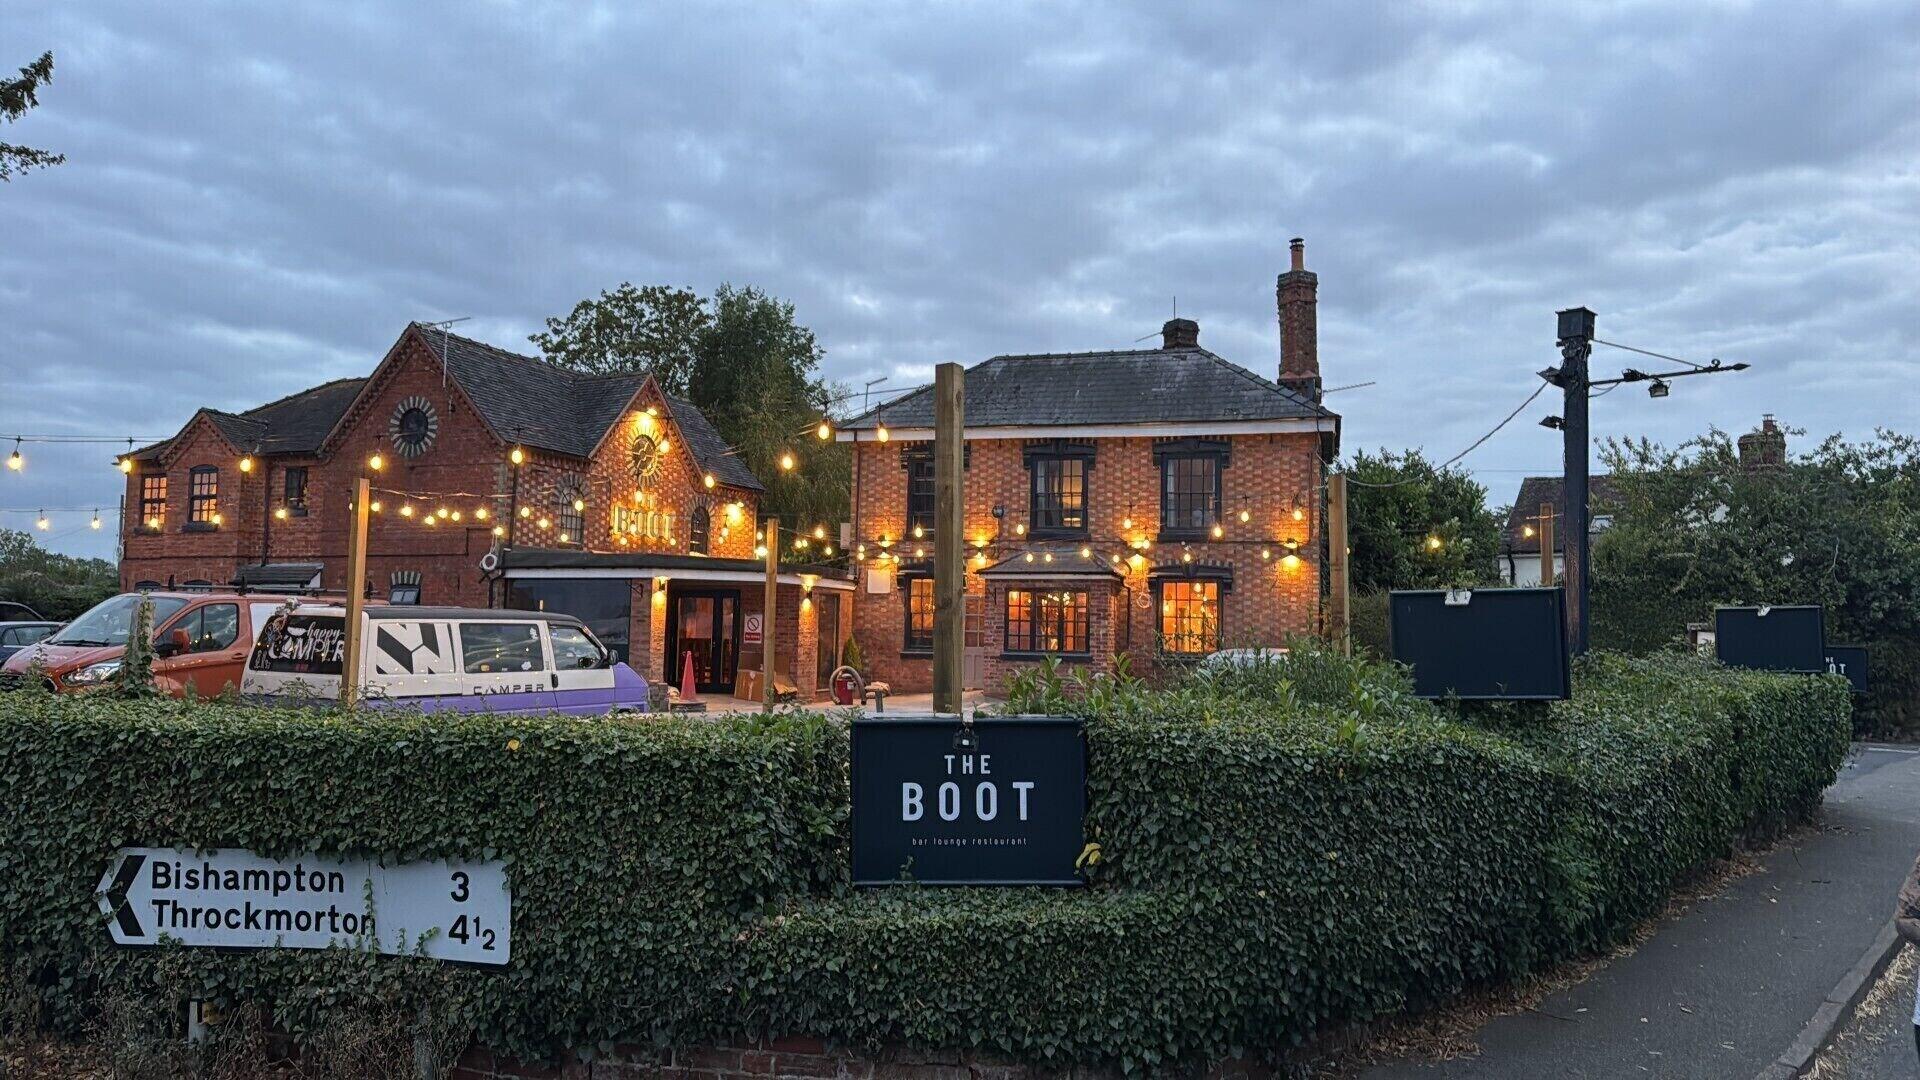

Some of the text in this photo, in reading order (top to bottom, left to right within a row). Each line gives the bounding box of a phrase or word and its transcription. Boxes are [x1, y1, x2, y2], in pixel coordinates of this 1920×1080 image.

[944, 755, 991, 775] THE
[902, 781, 1035, 822] BOOT
[912, 837, 1028, 847] bar lounge restaurant
[151, 861, 470, 902] Bishampton 3
[151, 899, 377, 936] Throckmorton
